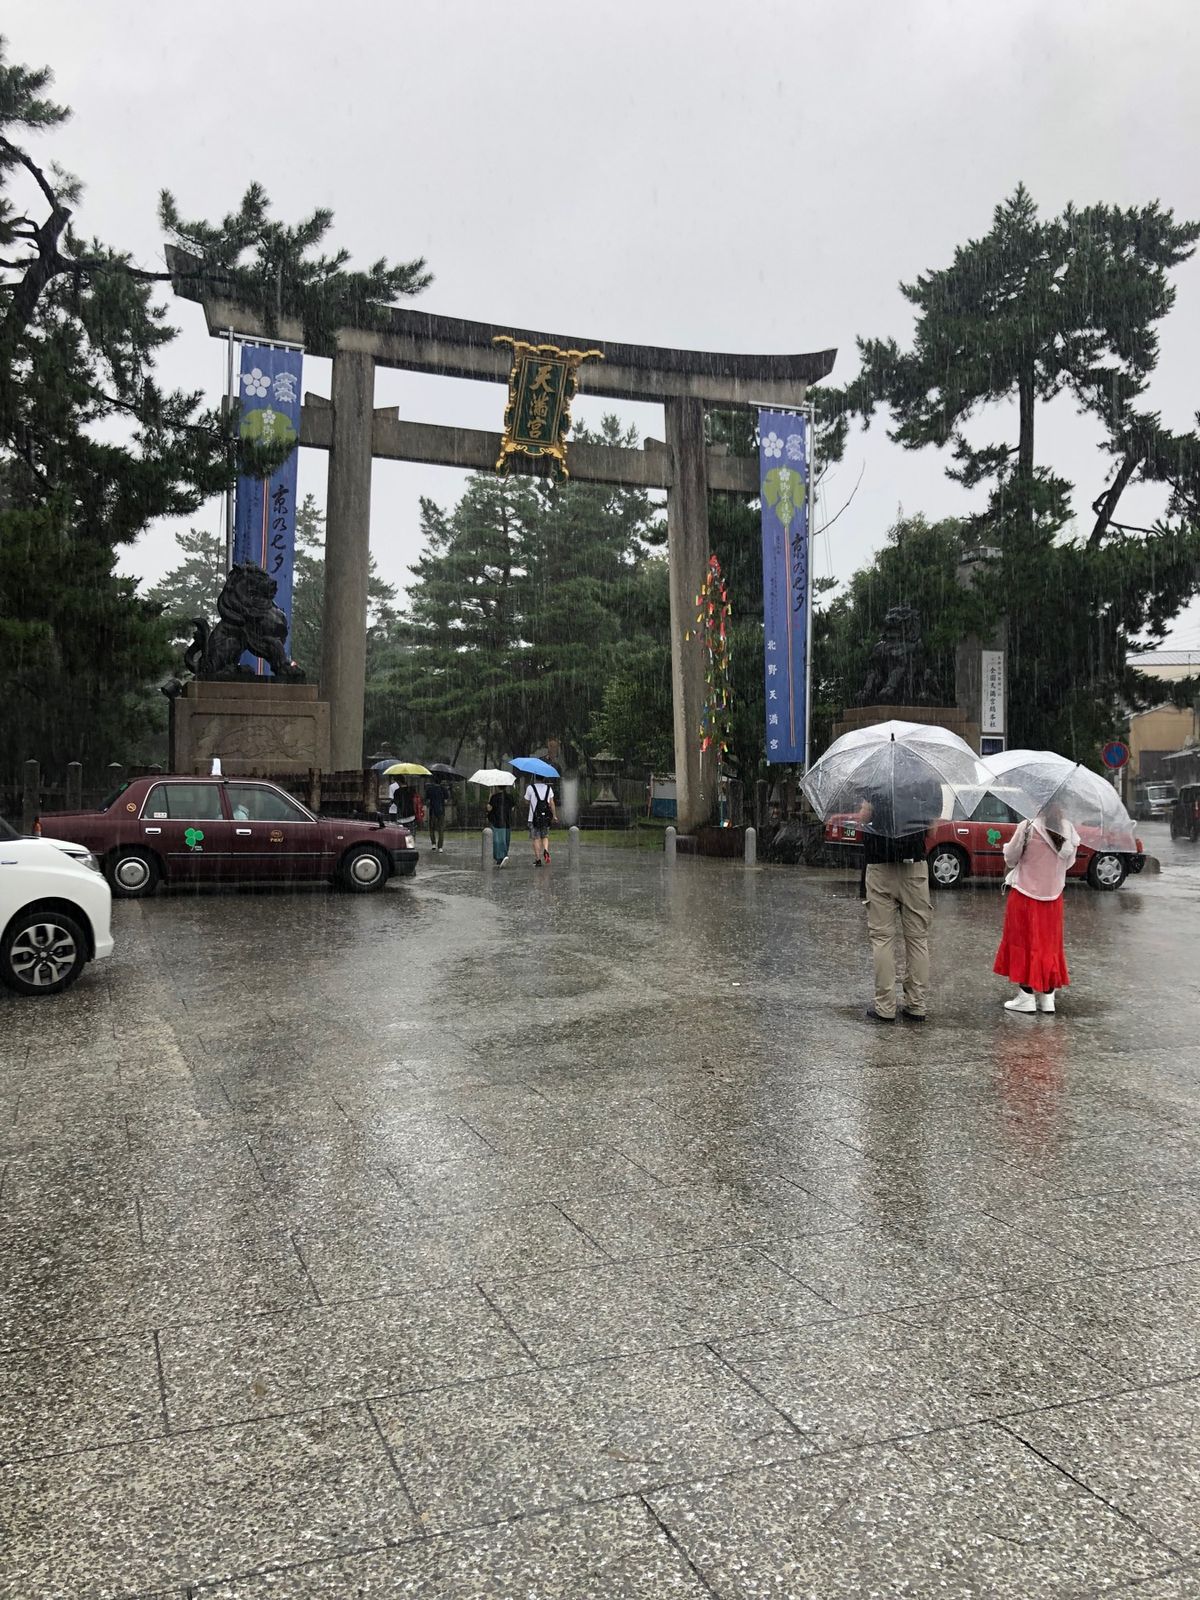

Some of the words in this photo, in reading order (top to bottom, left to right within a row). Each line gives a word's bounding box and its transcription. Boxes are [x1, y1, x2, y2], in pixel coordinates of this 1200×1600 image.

[527, 364, 556, 439] 天満宮
[767, 639, 779, 750] 北野天満宮
